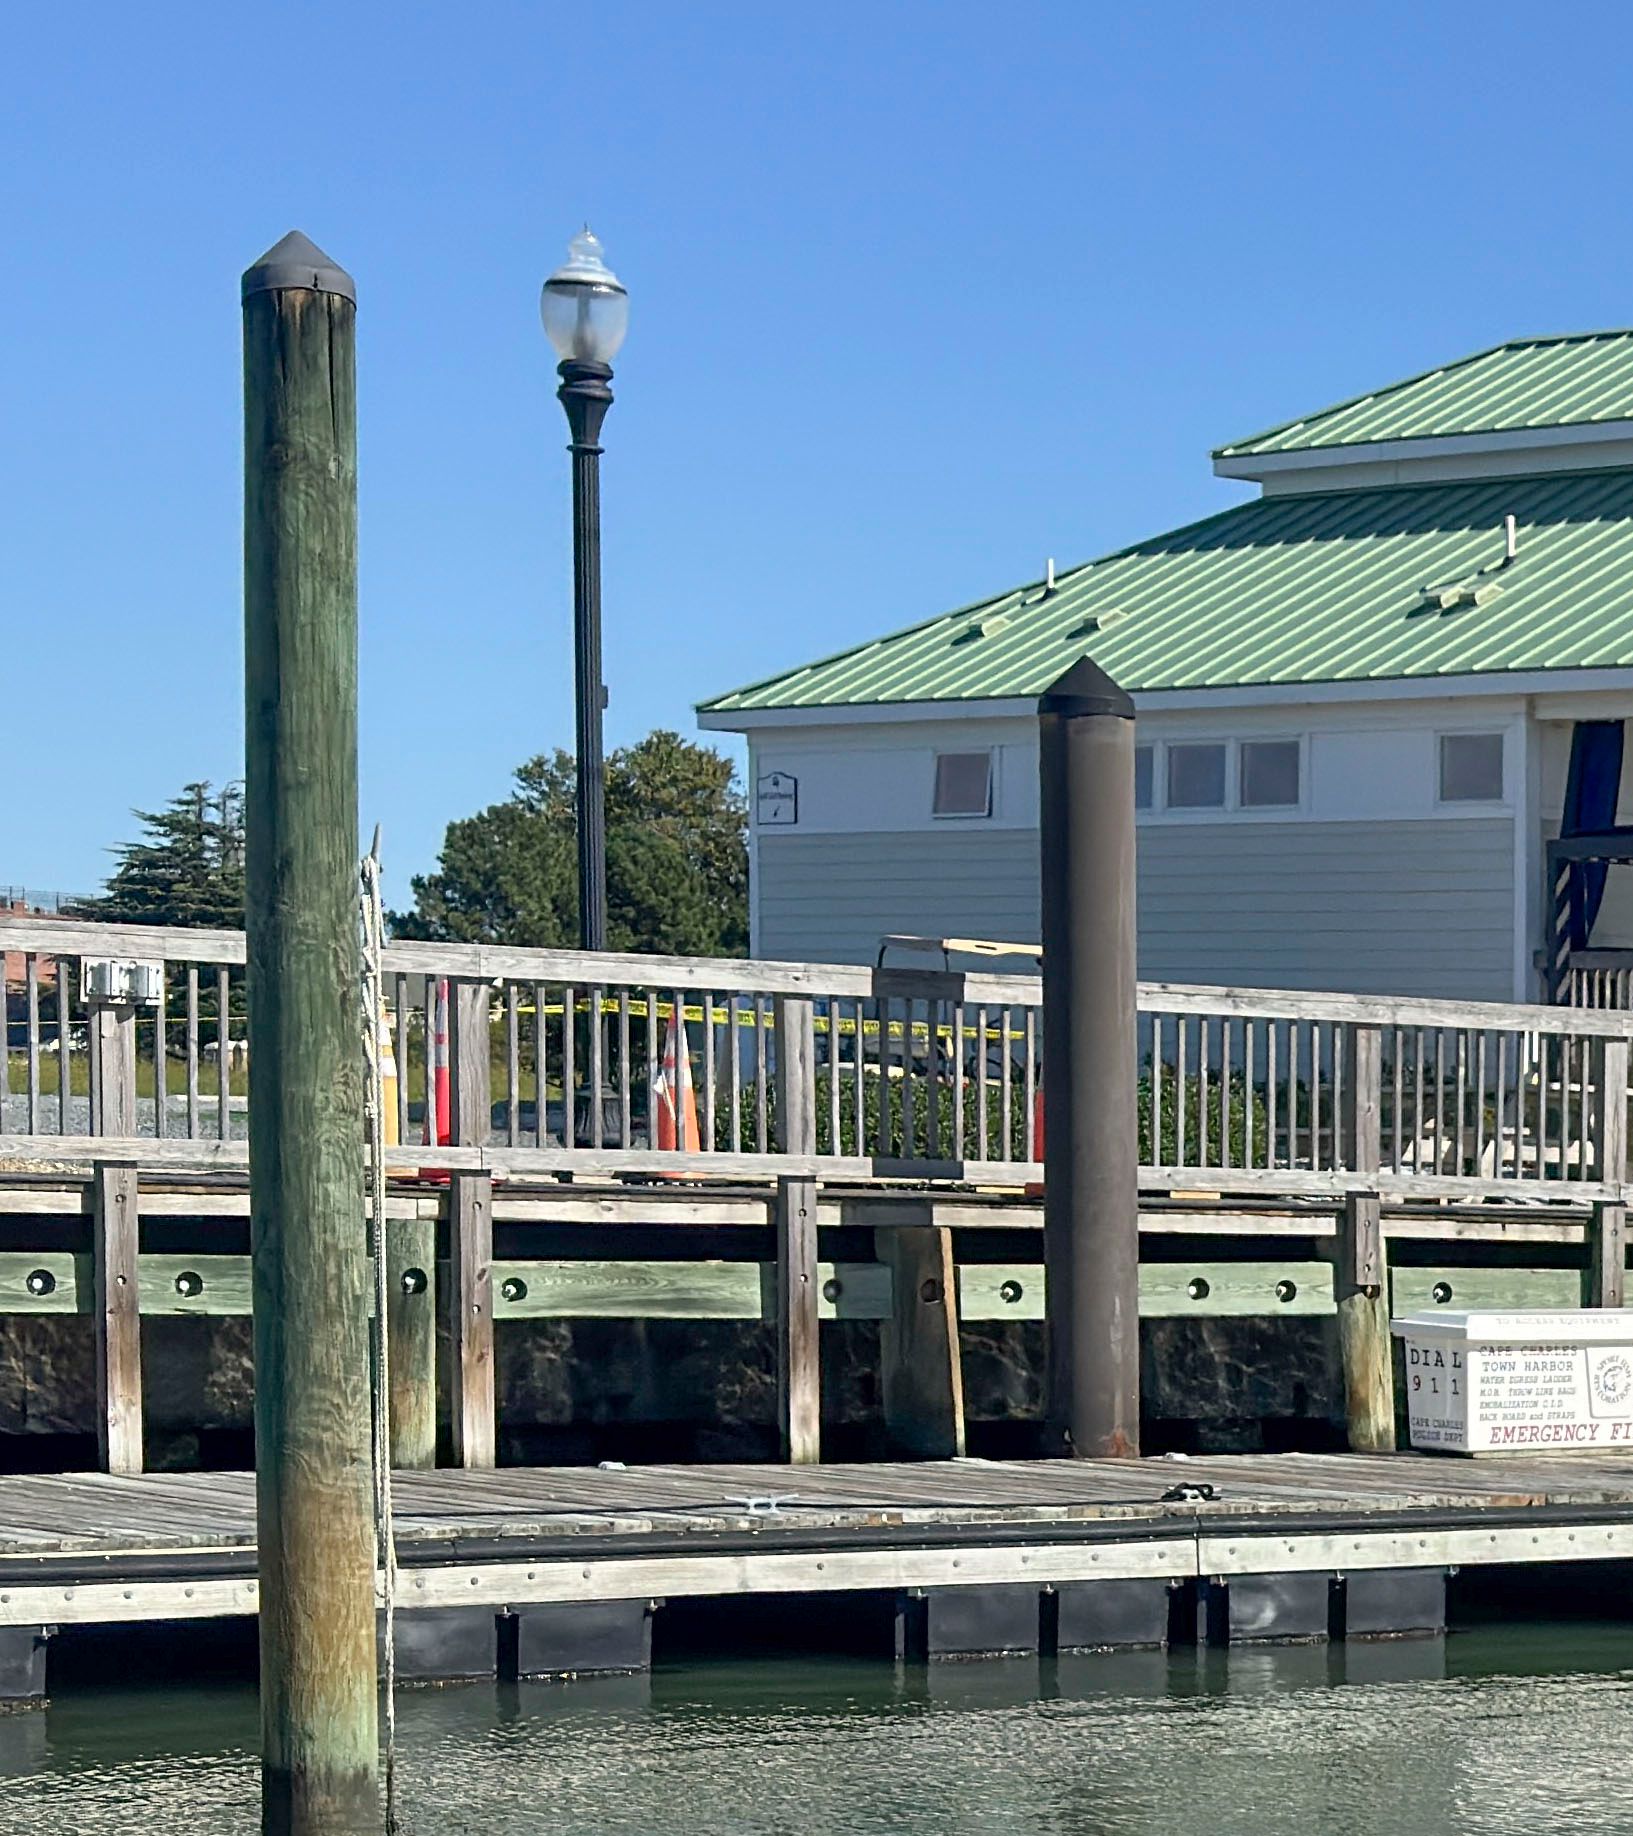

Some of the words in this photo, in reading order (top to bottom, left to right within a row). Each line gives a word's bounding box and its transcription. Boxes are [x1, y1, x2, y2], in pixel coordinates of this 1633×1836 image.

[1410, 1348, 1462, 1369] DIAL
[1479, 1345, 1513, 1357] CAPE
[1520, 1345, 1578, 1357] CHARLES
[1482, 1361, 1517, 1373] TOWN
[1524, 1360, 1574, 1372] HARBOR
[1490, 1424, 1600, 1444] EMERGENCY
